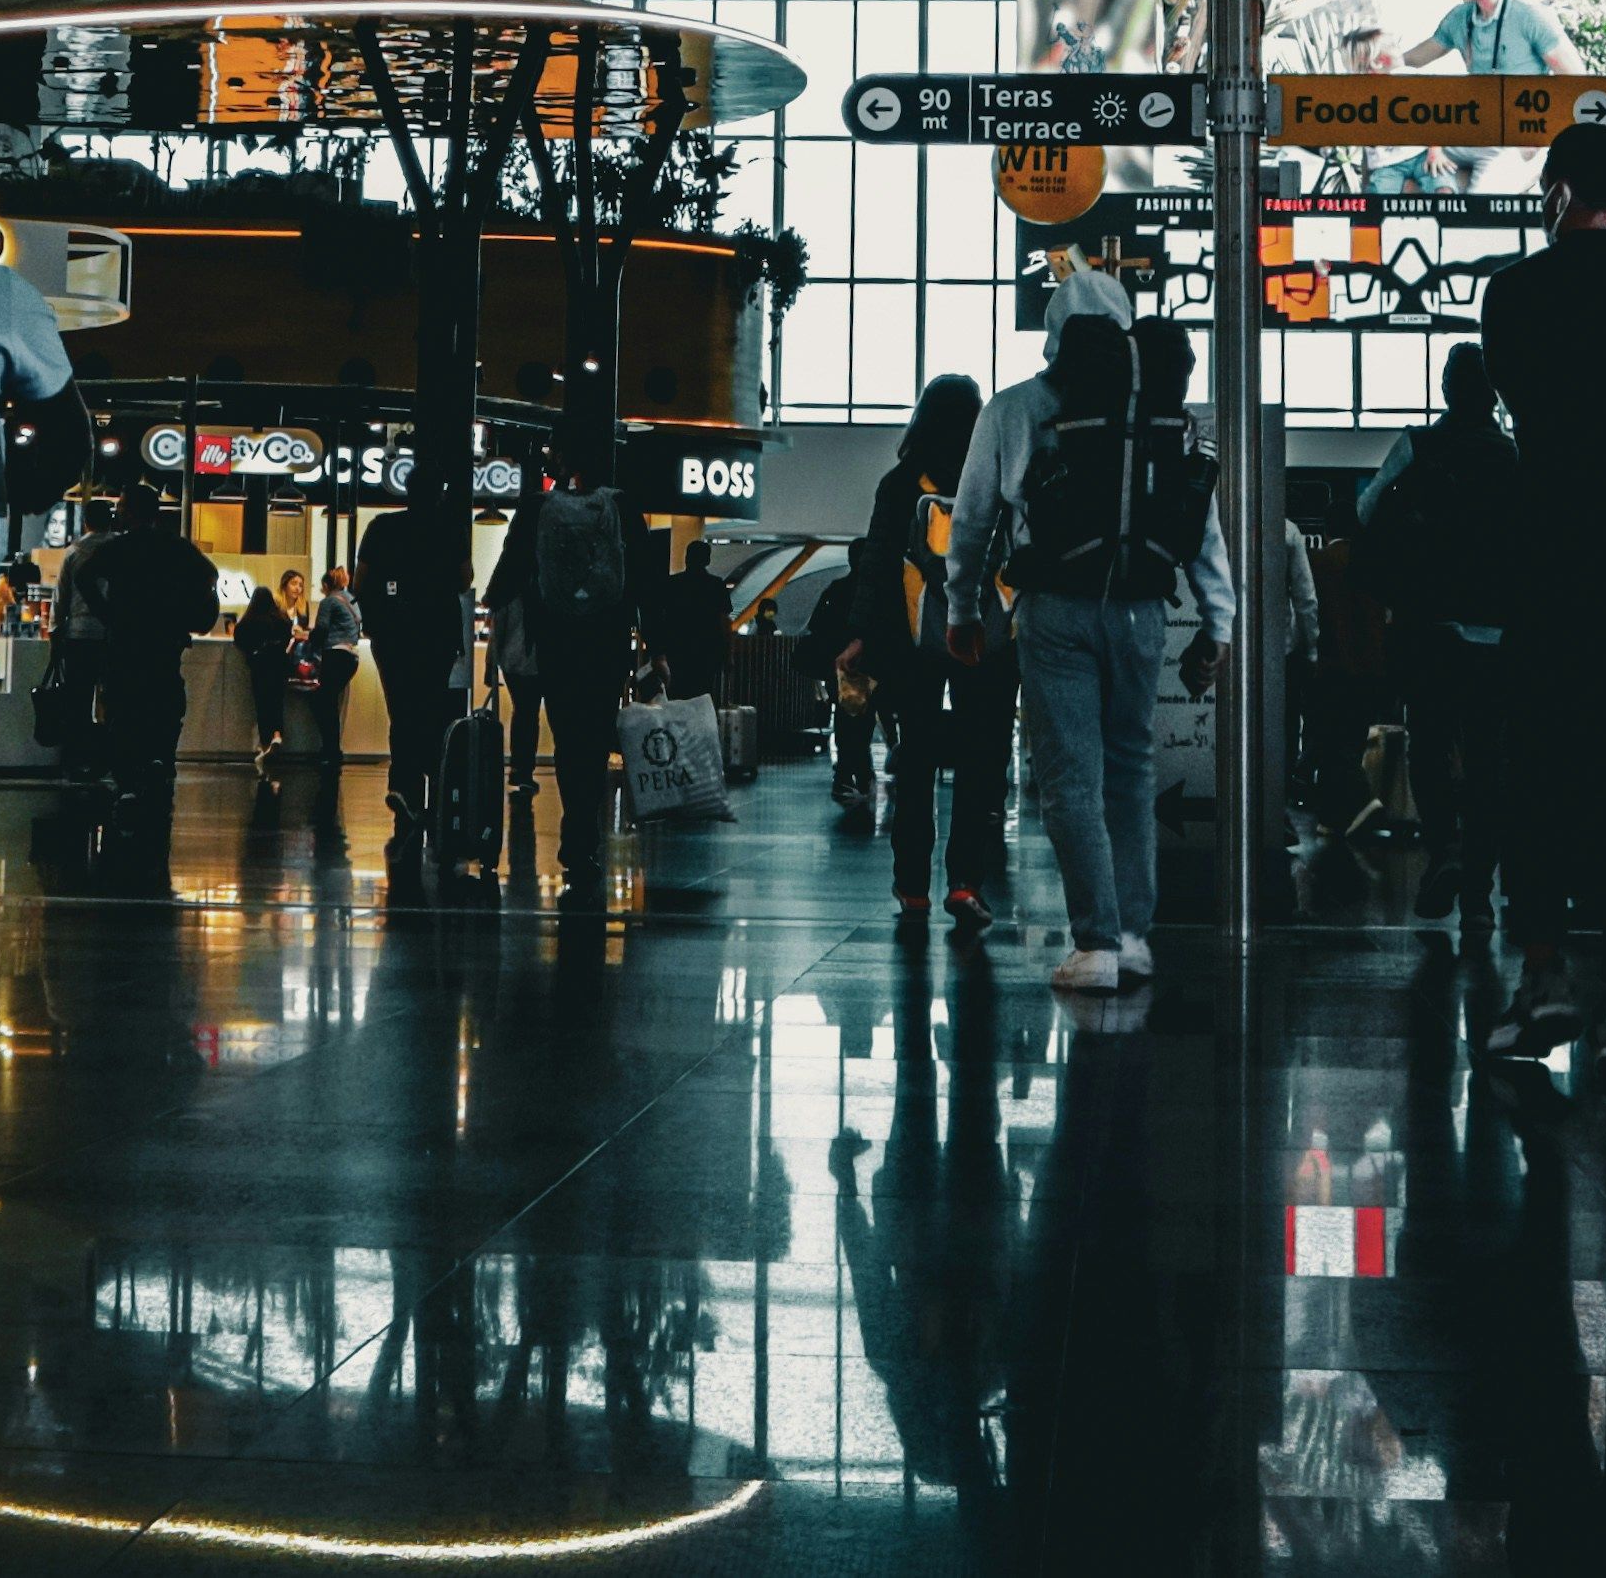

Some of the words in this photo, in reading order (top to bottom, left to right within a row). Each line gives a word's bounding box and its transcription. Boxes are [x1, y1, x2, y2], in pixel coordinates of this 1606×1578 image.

[919, 89, 951, 111] 90
[979, 84, 1053, 108] Teras
[1514, 89, 1550, 113] 40
[1295, 95, 1378, 125] Food
[1387, 96, 1480, 125] Court
[922, 114, 948, 130] mt
[979, 116, 1082, 140] Terrace
[1518, 118, 1548, 134] mt
[1136, 198, 1192, 211] FASHION
[1265, 198, 1313, 211] FAMILY
[1317, 198, 1367, 212] PALACE
[1383, 199, 1432, 212] LUXURY
[1438, 199, 1468, 212] HILL
[1489, 199, 1521, 212] ICON
[200, 444, 228, 468] illy
[682, 458, 756, 499] BOSS
[637, 766, 694, 792] PERA
